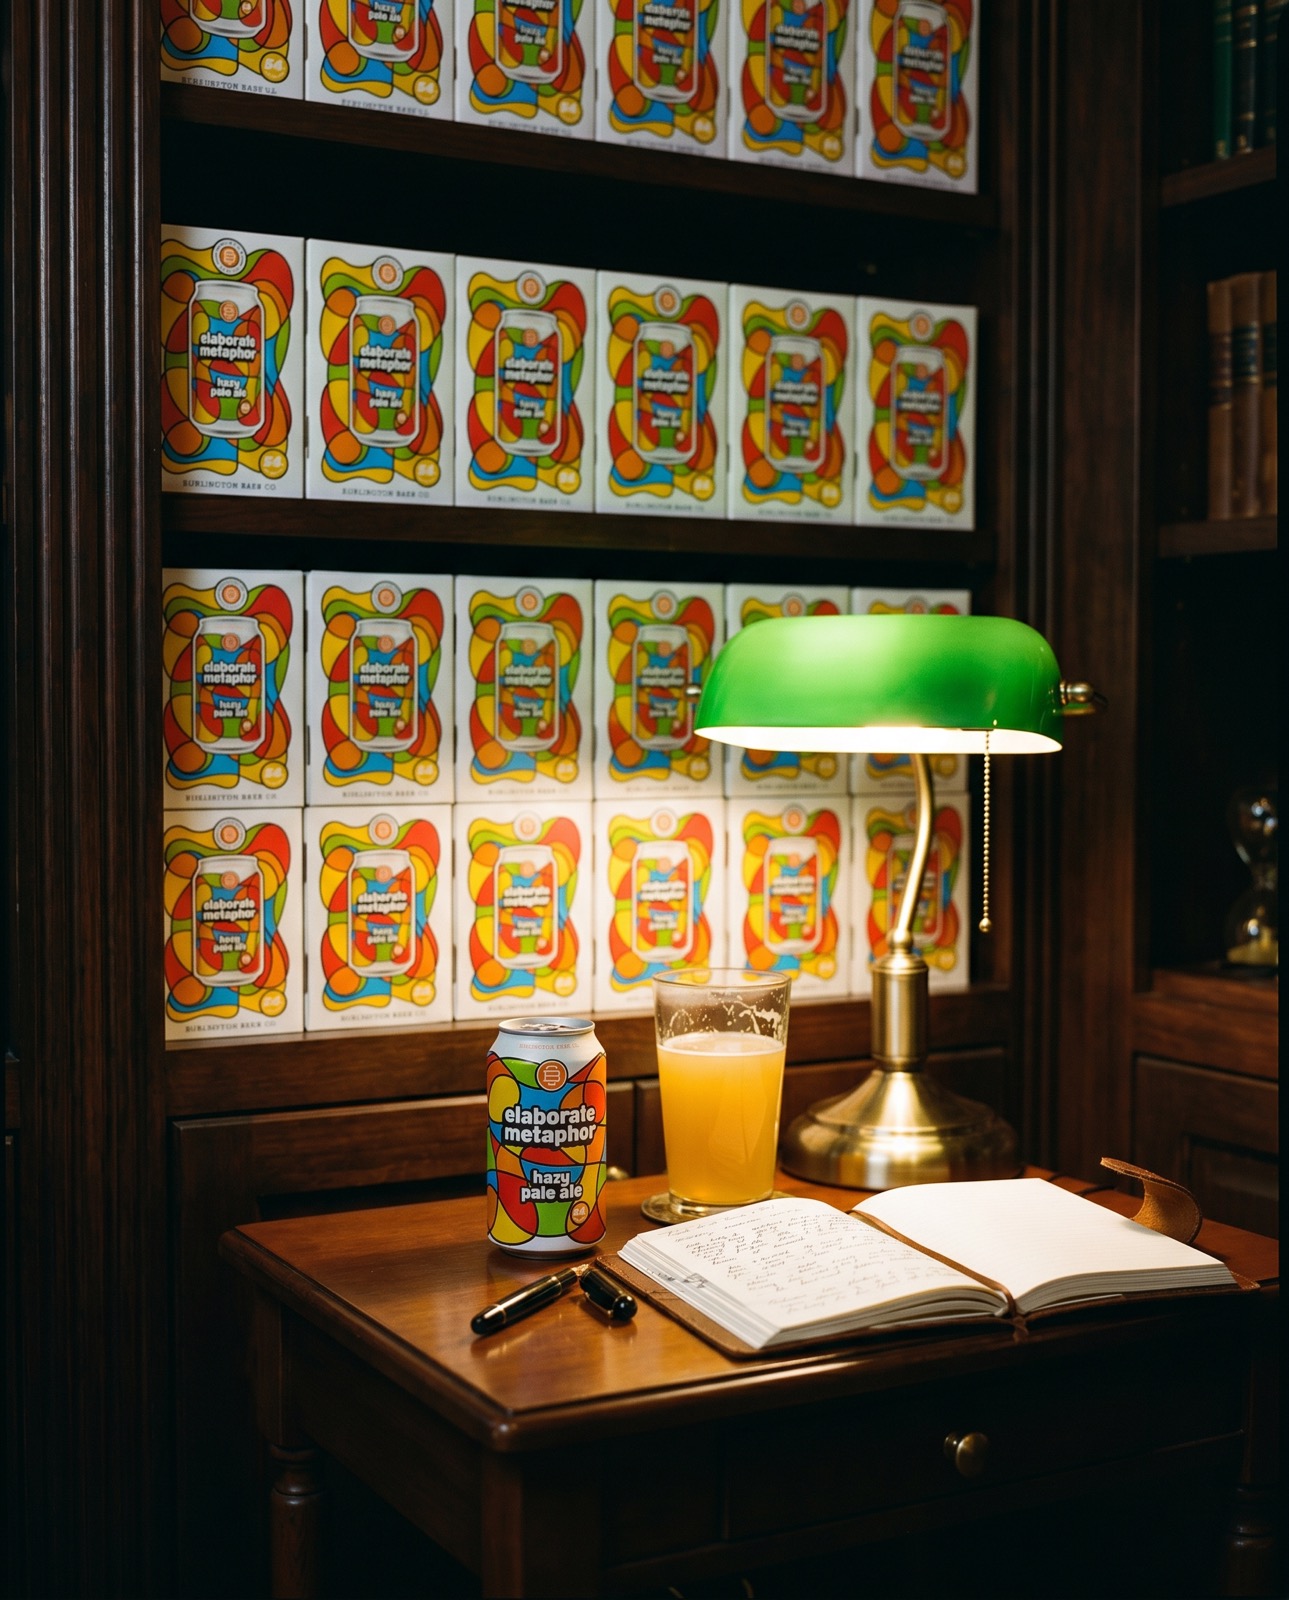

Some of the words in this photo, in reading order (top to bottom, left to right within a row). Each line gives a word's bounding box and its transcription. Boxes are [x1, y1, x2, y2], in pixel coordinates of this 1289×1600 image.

[200, 332, 256, 348] elaborate
[200, 345, 257, 361] metaphor
[504, 1104, 596, 1125] elaborate
[504, 1124, 597, 1147] metaphor
[532, 1170, 571, 1187] hazy
[521, 1185, 557, 1202] pale
[559, 1184, 583, 1199] ale
